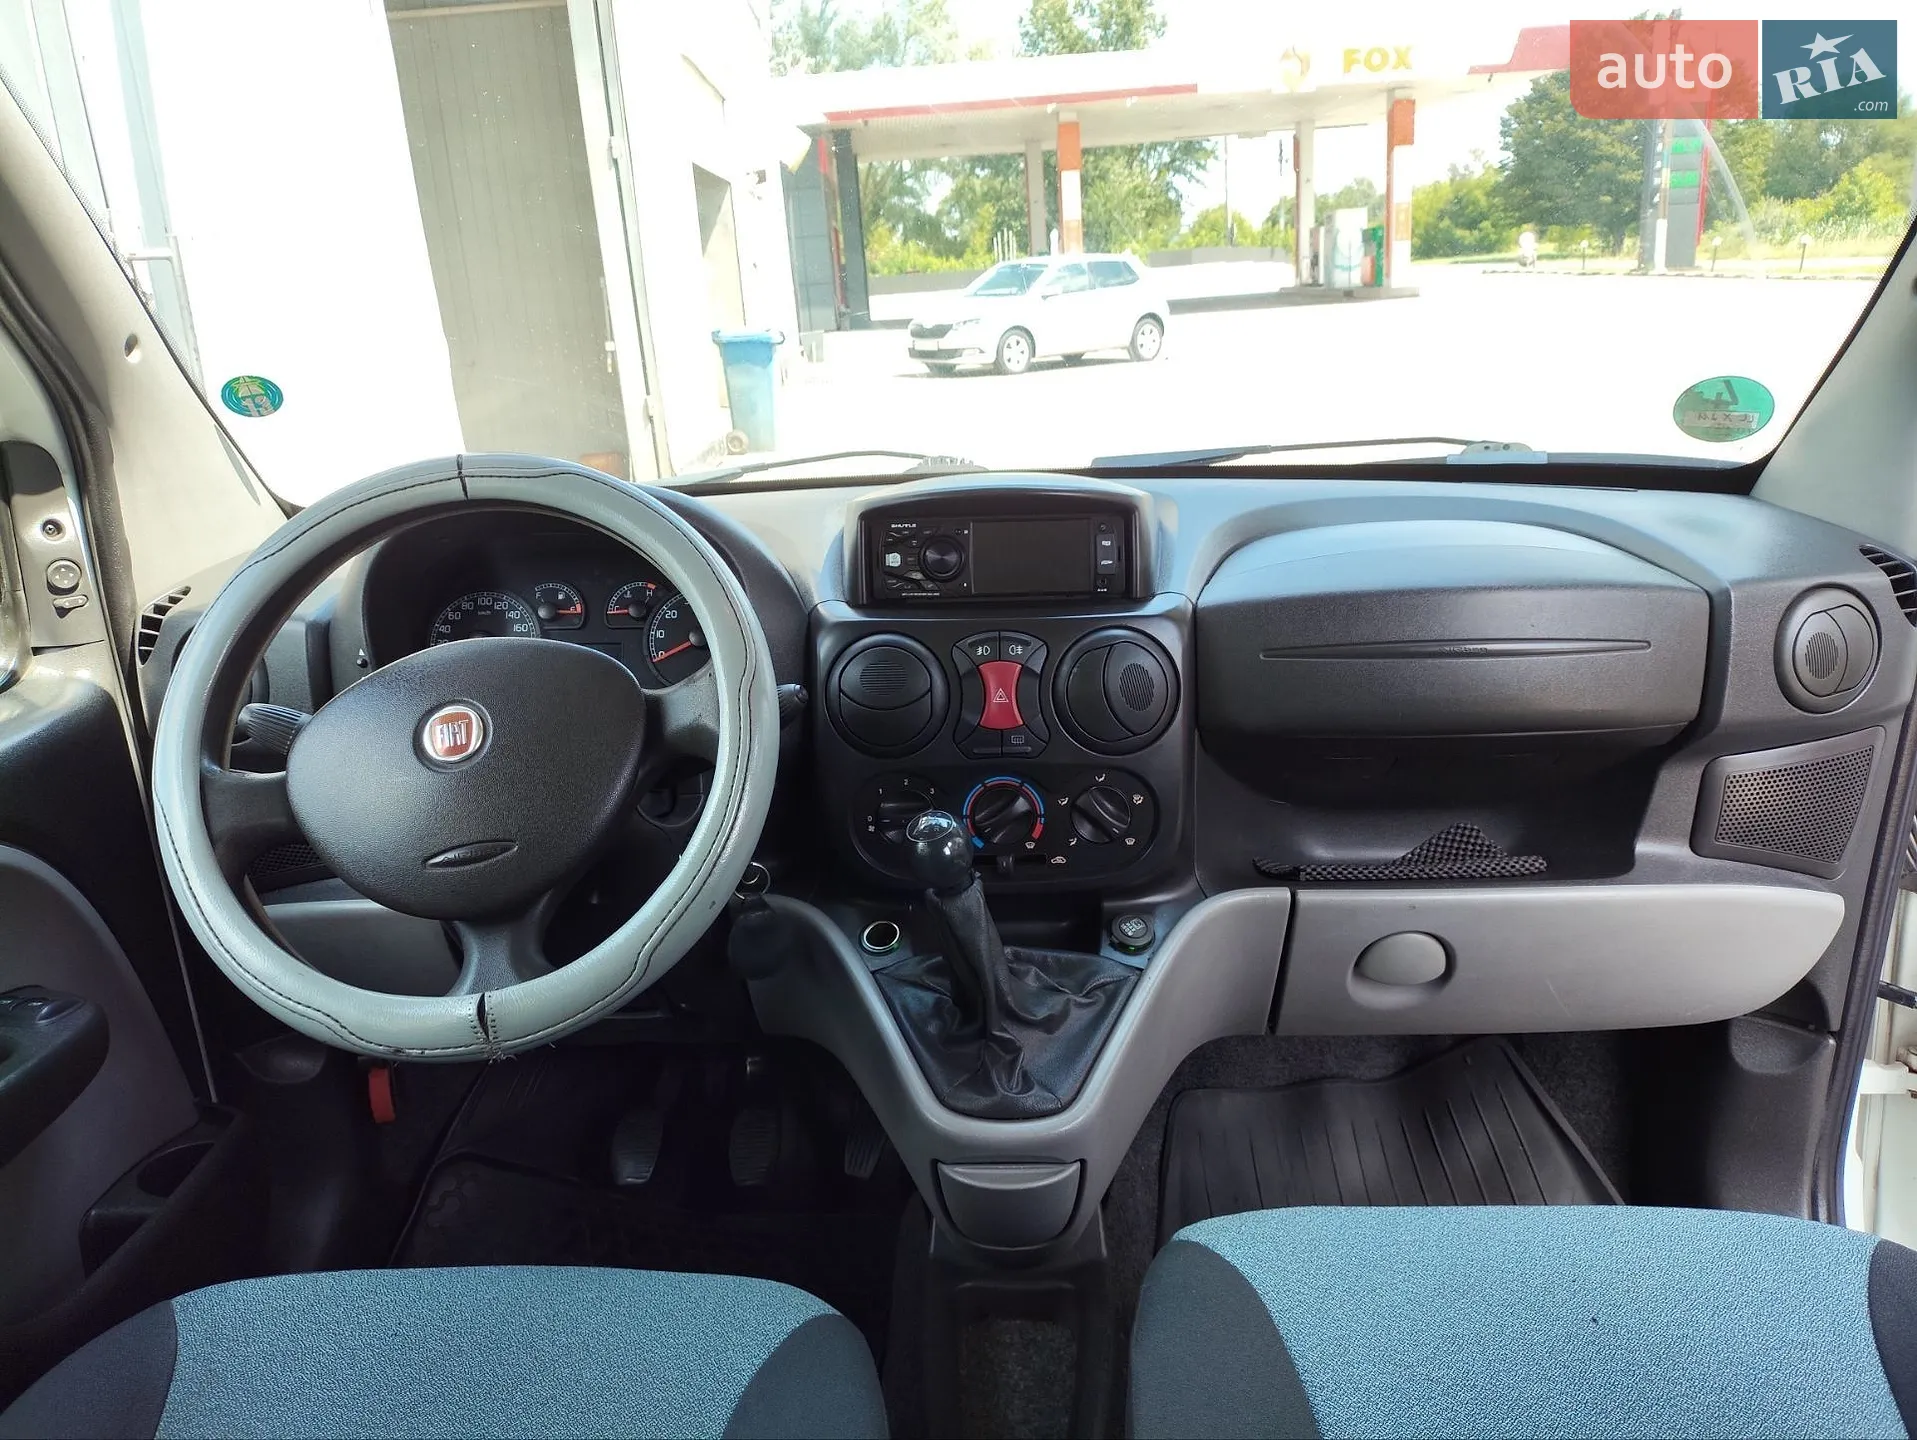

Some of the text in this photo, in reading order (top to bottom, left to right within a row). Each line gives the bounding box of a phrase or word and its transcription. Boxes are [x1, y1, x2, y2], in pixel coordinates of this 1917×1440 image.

[1343, 45, 1413, 74] FOX
[461, 601, 474, 610] 80
[477, 597, 492, 606] 100
[494, 601, 509, 610] 120
[448, 611, 461, 620] 60
[505, 610, 521, 619] 140
[665, 611, 678, 619] 20
[438, 624, 451, 633] 40
[513, 623, 528, 632] 160
[656, 630, 665, 639] 10
[435, 720, 469, 748] FIAT
